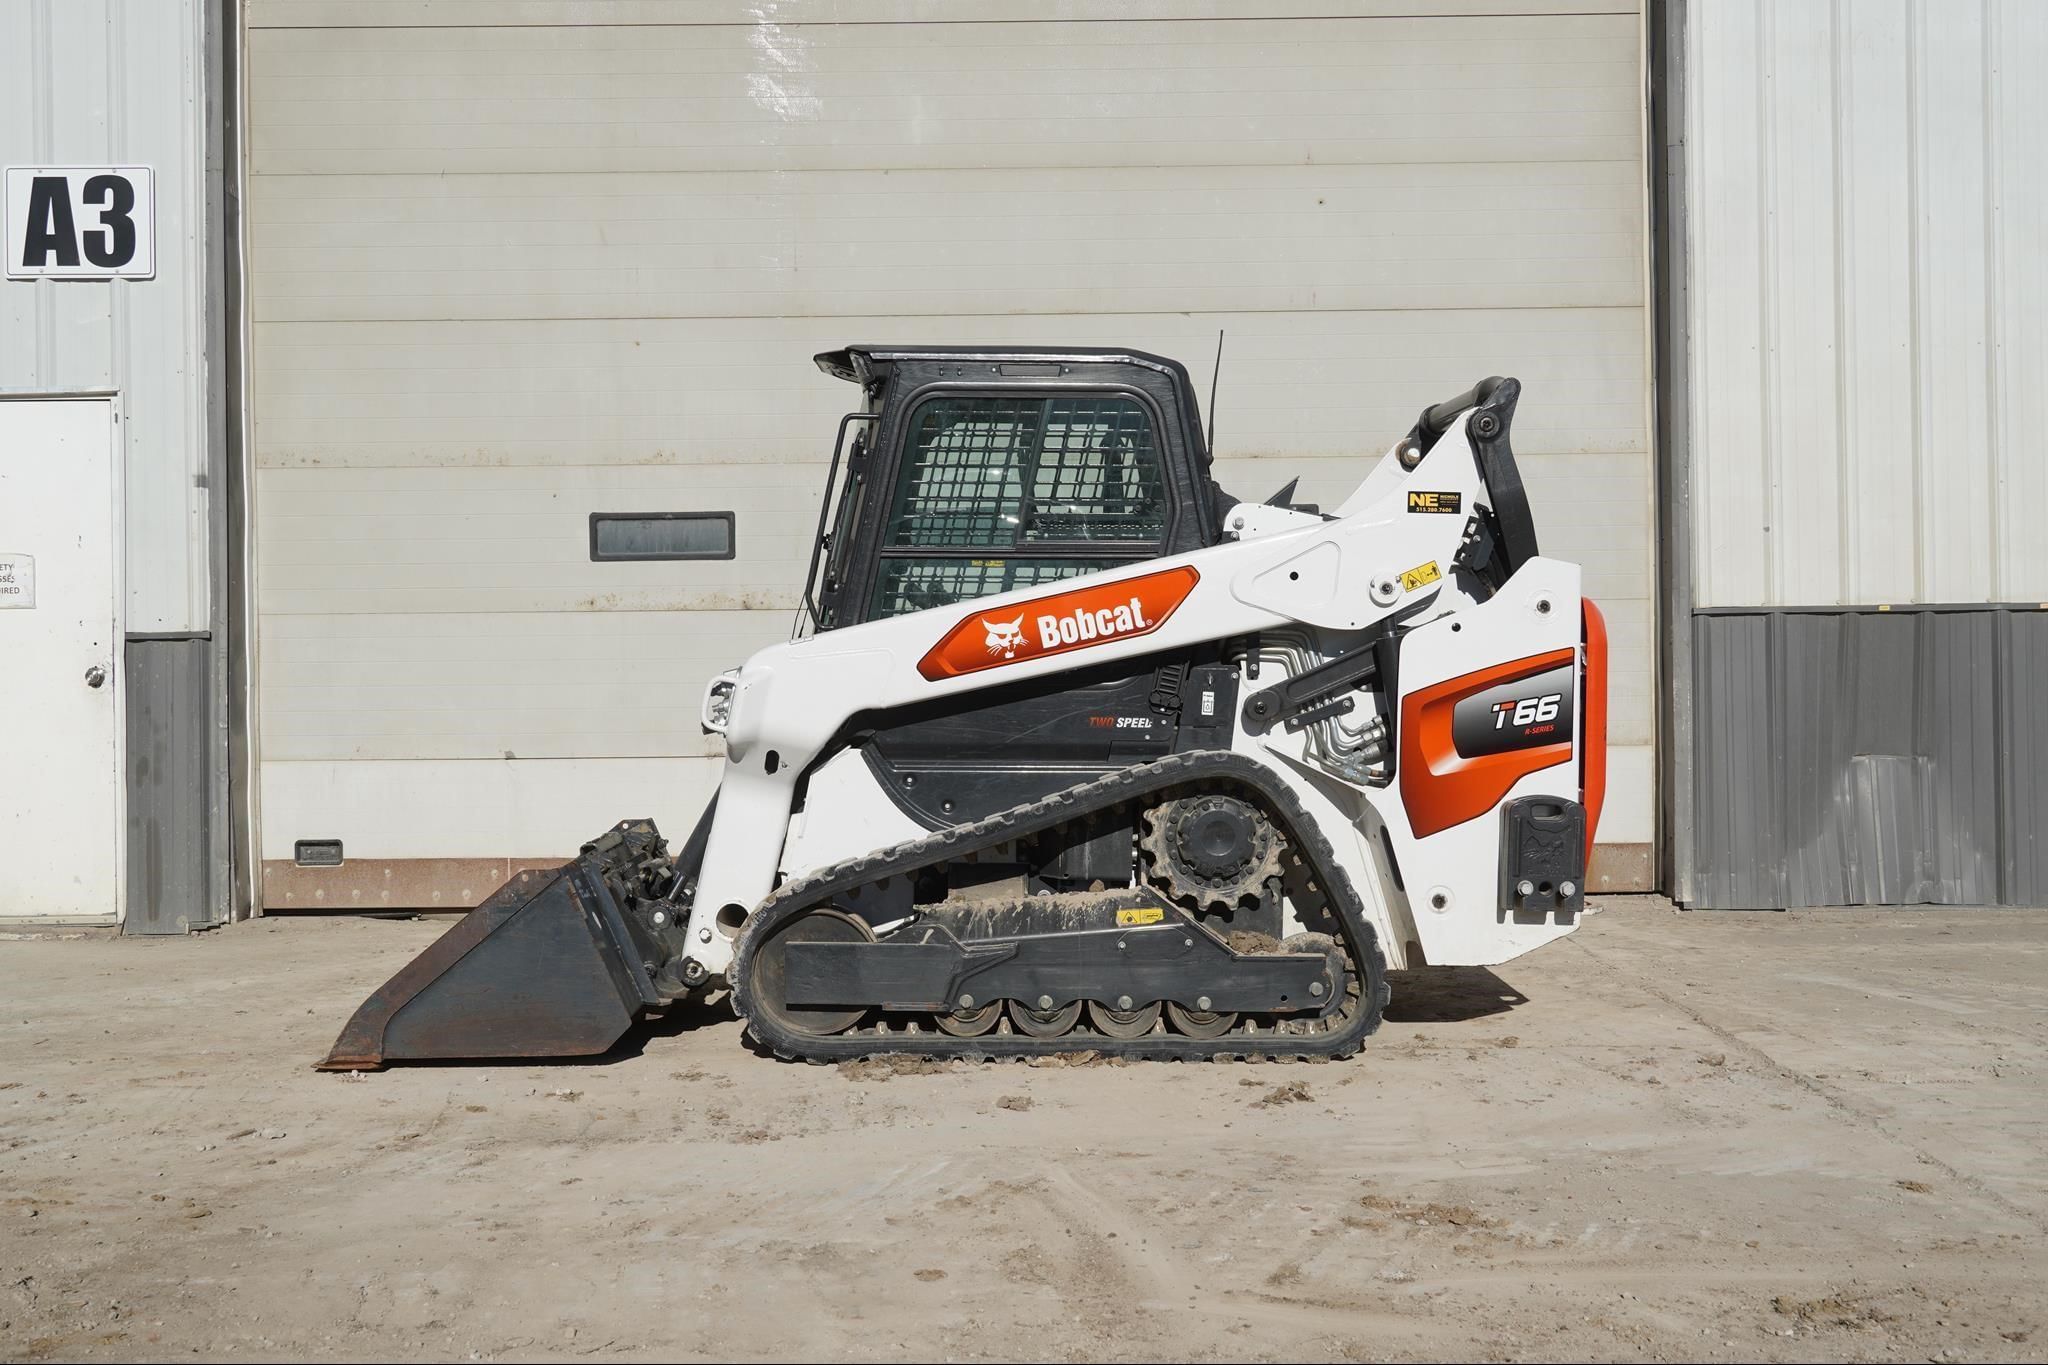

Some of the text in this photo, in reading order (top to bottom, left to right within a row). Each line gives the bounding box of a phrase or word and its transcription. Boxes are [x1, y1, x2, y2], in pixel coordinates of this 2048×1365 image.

[23, 175, 136, 268] A3
[1409, 493, 1439, 507] NE
[1037, 597, 1146, 649] Bobcat
[1089, 716, 1115, 728] TWO
[1492, 694, 1561, 730] T66
[1525, 724, 1554, 735] R-SERIES
